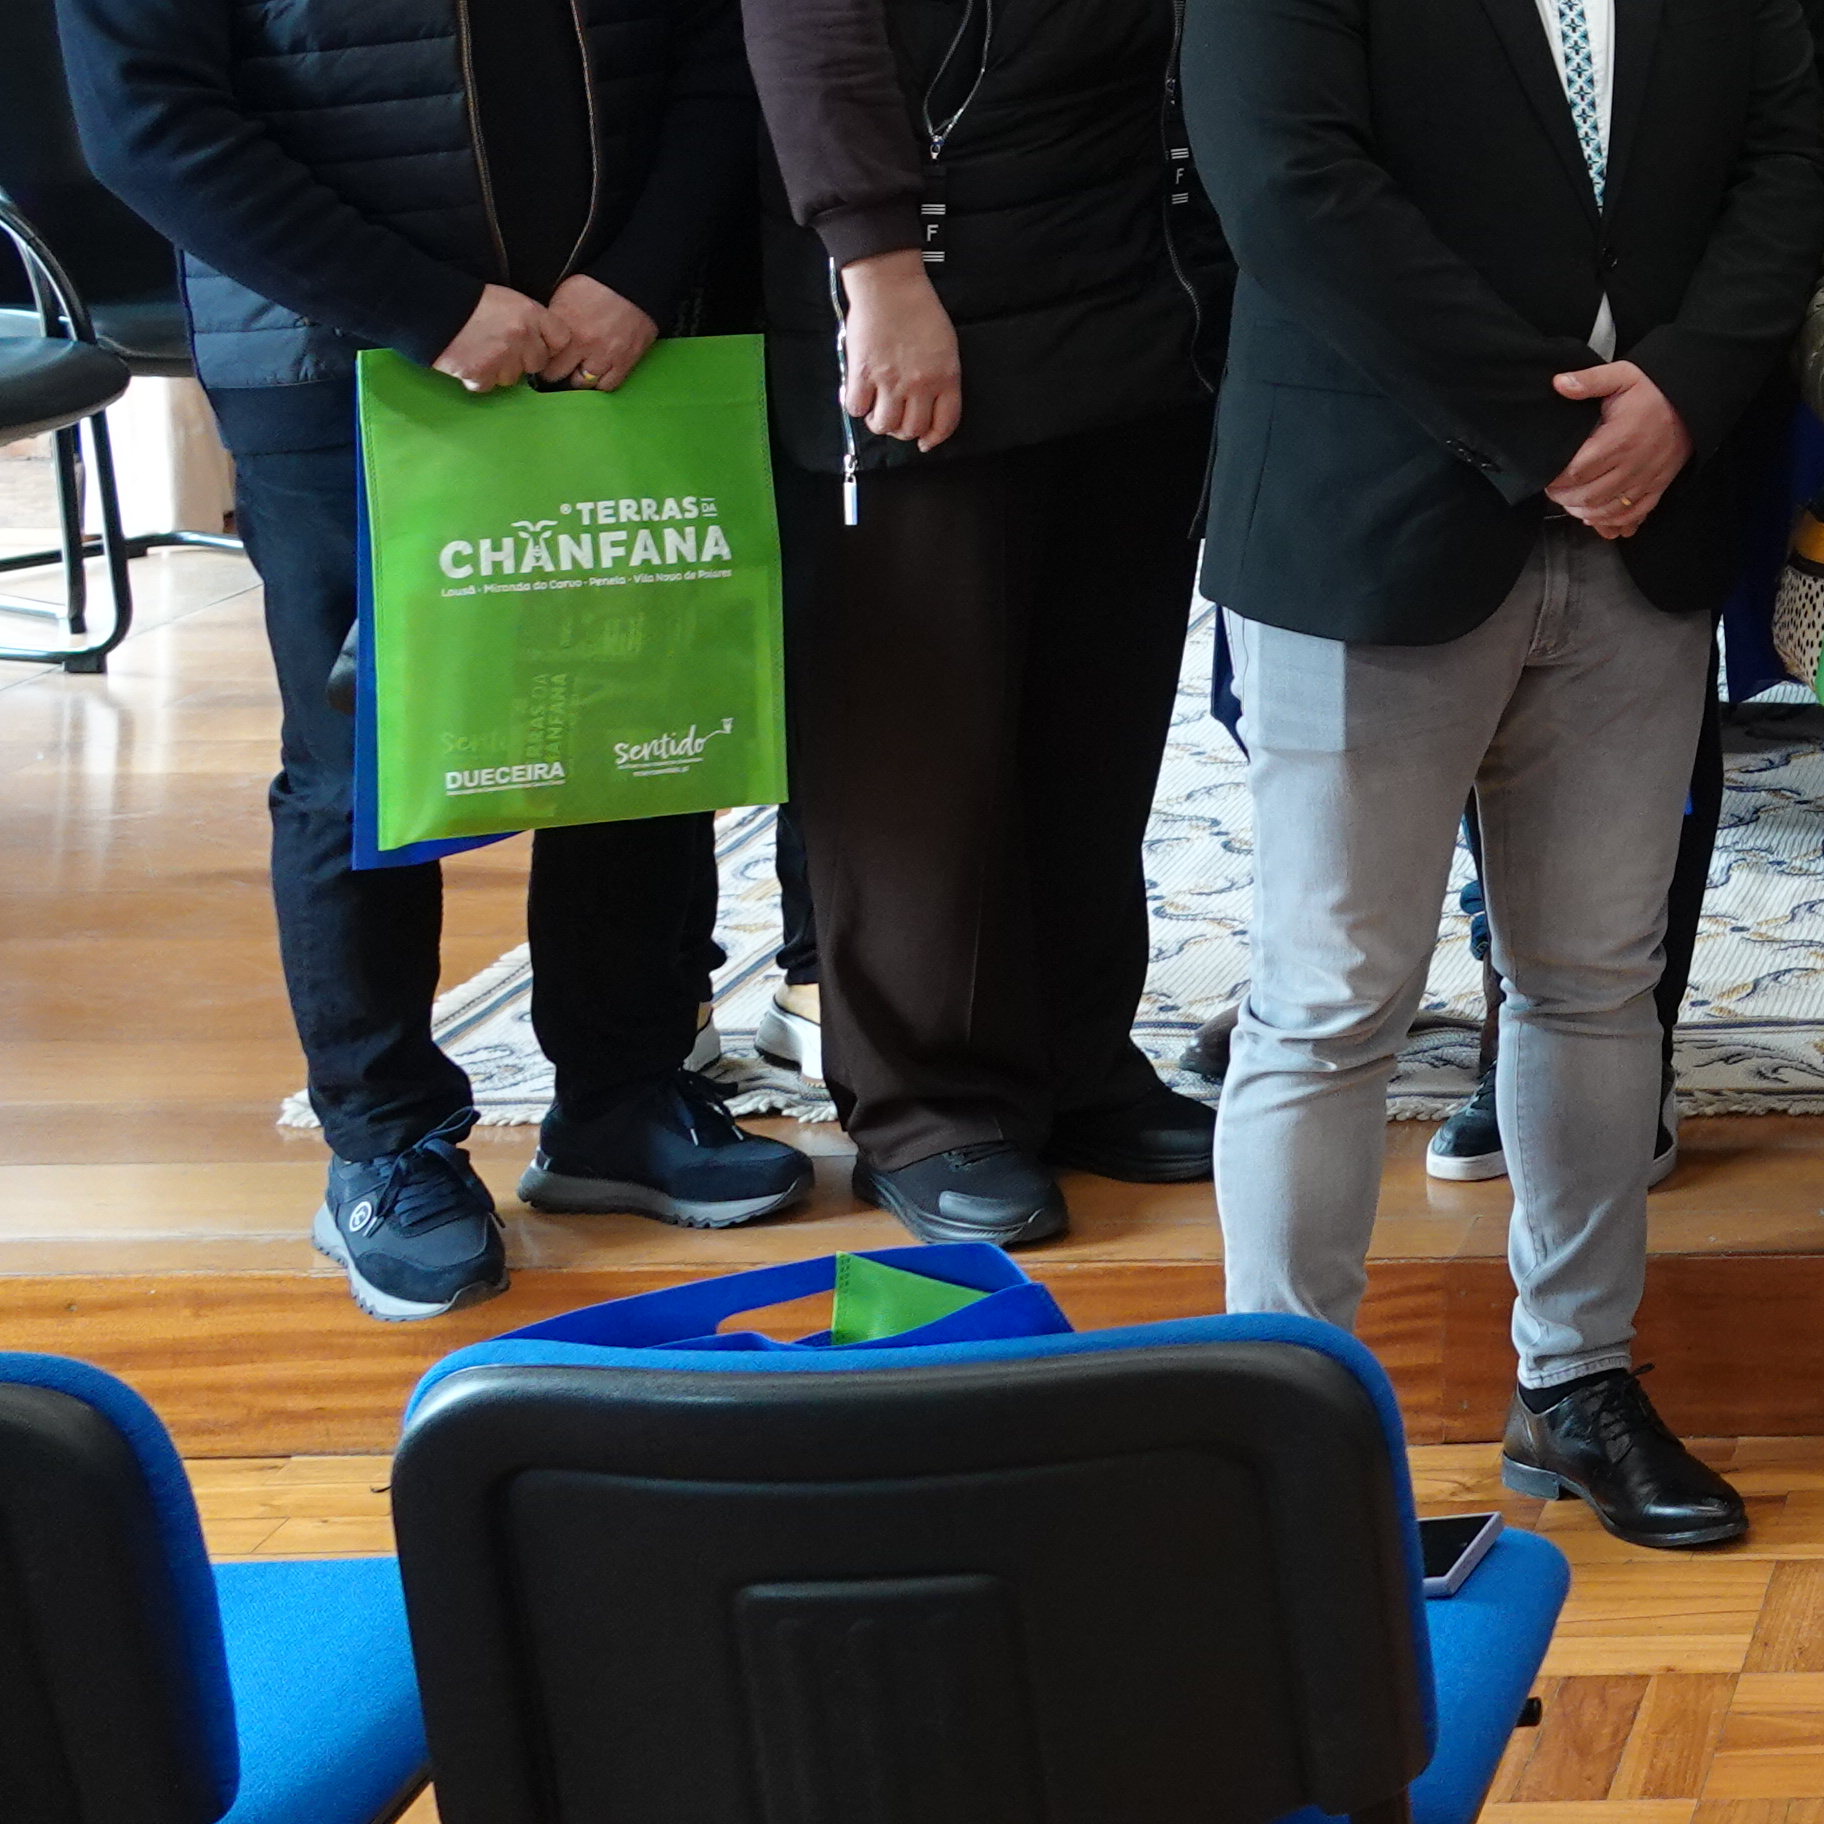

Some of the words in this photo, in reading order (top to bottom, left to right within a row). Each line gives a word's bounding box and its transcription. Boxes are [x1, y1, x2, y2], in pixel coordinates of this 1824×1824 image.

[1175, 167, 1185, 185] F
[926, 223, 939, 242] F
[576, 496, 700, 526] TERRAS
[701, 502, 718, 513] DA
[438, 523, 732, 580] CHANFANA
[613, 724, 707, 765] Sentido
[445, 761, 566, 790] DUECEIRA
